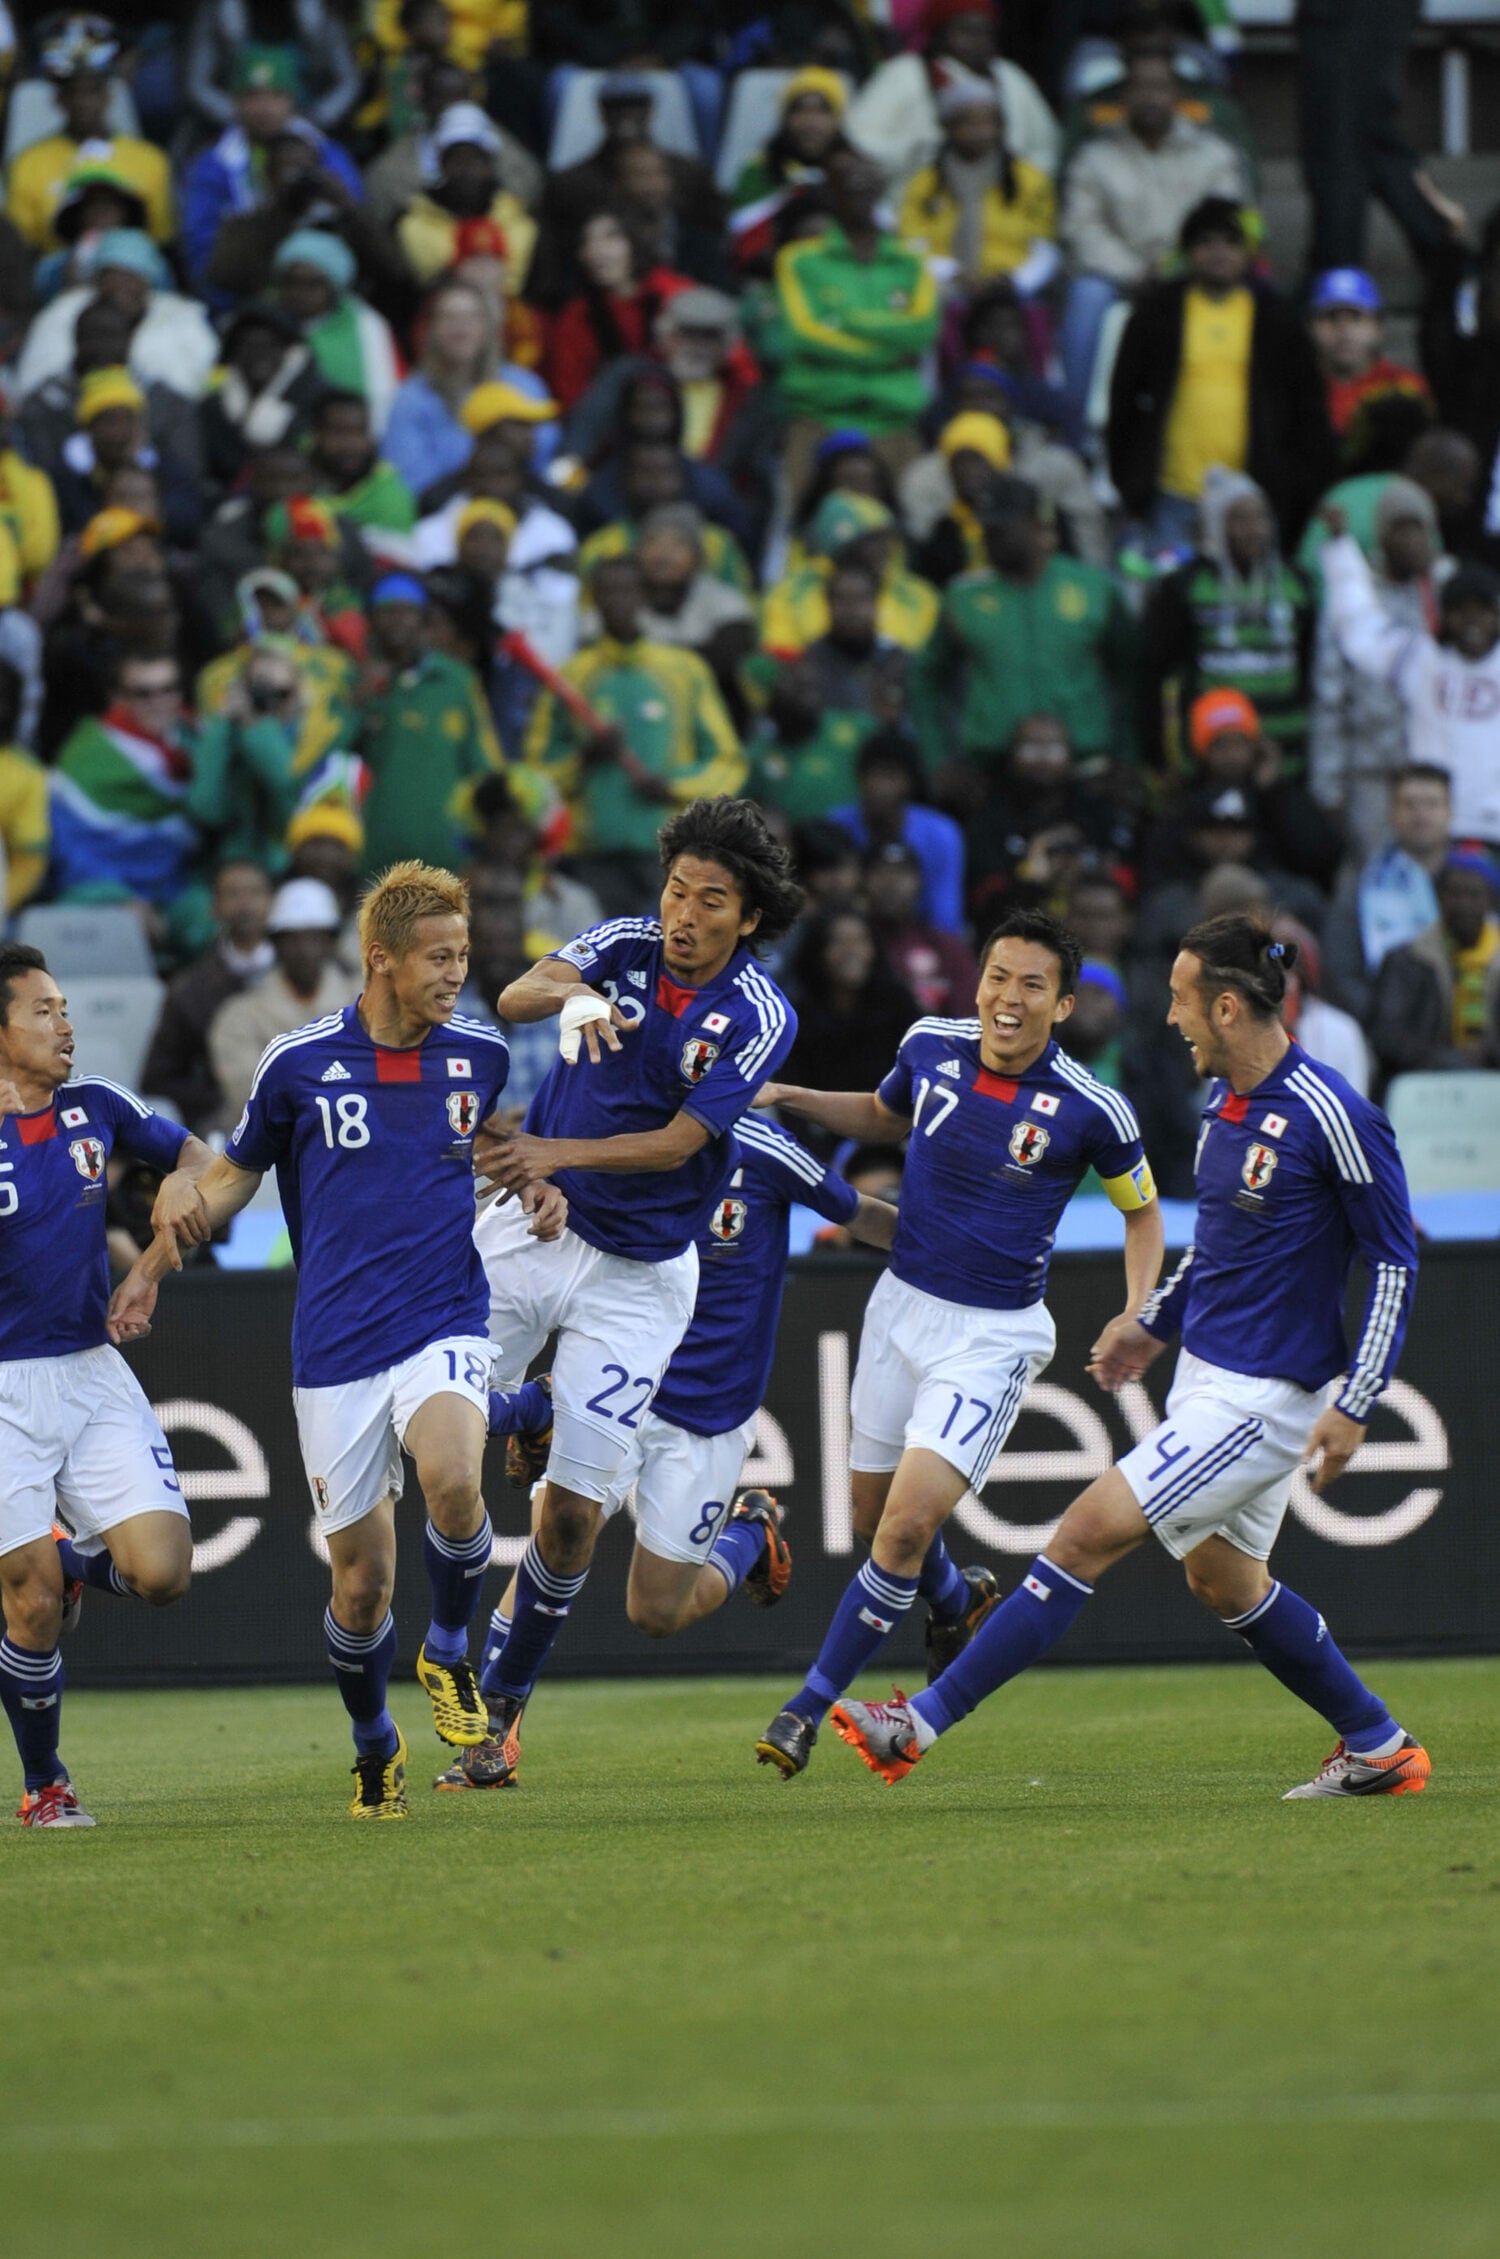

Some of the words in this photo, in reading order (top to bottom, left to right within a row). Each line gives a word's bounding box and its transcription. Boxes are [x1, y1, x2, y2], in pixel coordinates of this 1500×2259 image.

[315, 1093, 371, 1149] 18
[913, 1077, 959, 1137] 17
[443, 1350, 487, 1393] 18
[586, 1364, 654, 1428] 22
[939, 1392, 993, 1447] 17
[151, 1446, 180, 1492] 5
[1148, 1430, 1191, 1482] 4
[689, 1501, 725, 1545] 8
